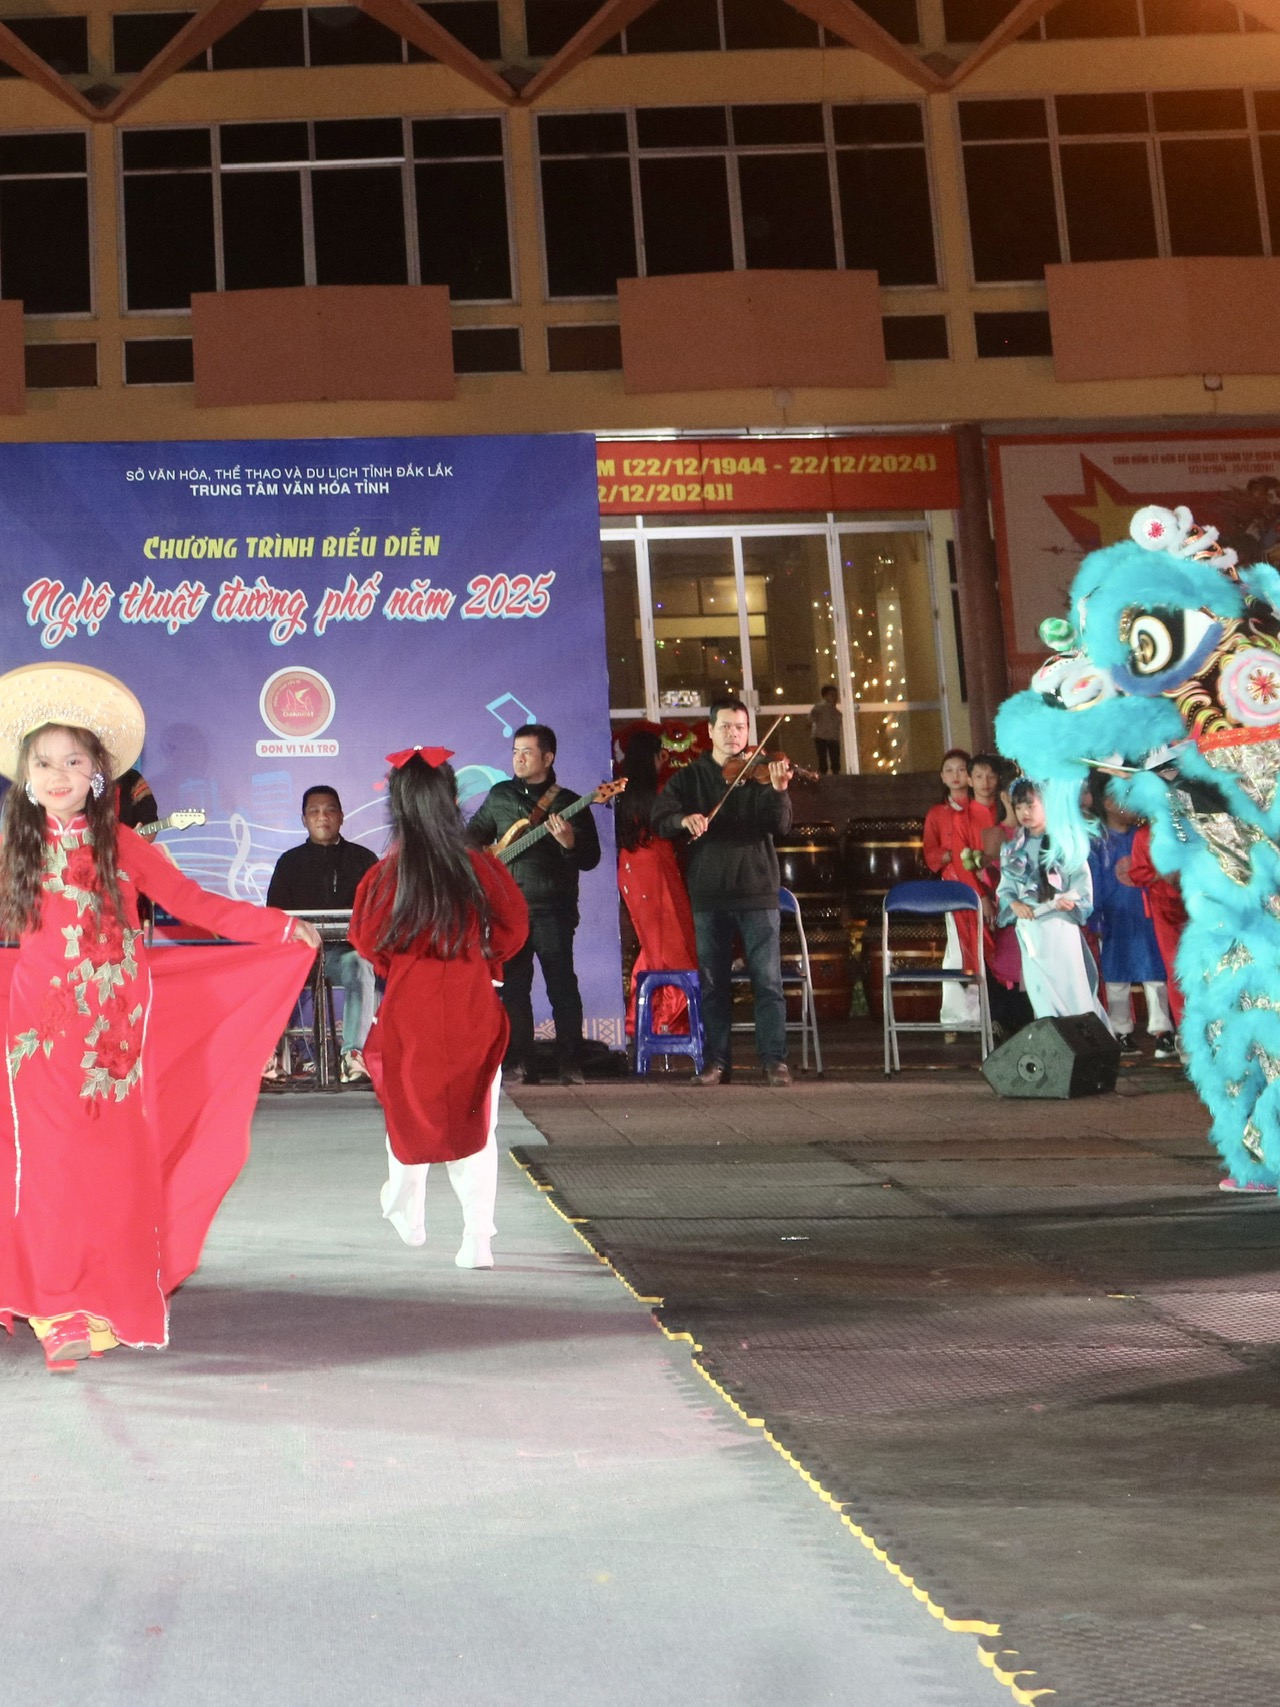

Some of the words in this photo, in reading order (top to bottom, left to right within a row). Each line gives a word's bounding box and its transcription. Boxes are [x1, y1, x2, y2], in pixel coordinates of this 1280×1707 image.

[126, 467, 144, 481] SỞ
[148, 468, 175, 480] VĂN
[179, 468, 211, 481] HÓA,
[214, 465, 241, 480] THỂ
[245, 468, 282, 480] THAO
[284, 466, 302, 479] VÀ
[306, 468, 325, 479] DU
[328, 467, 358, 480] LỊCH
[362, 464, 393, 478] TỈNH
[396, 463, 424, 477] ĐẮK
[427, 463, 454, 477] LẮK
[623, 457, 767, 476] (22/12/1944
[789, 454, 937, 474] 22/12/2024)
[190, 484, 242, 496] TRUNG
[246, 481, 278, 495] TÂM
[283, 480, 314, 495] VĂN
[318, 480, 351, 495] HÓA
[354, 479, 390, 494] TỈNH
[143, 536, 237, 559] CHƯƠNG
[246, 533, 315, 558] TRÌNH
[322, 527, 377, 557] BIỂU
[384, 527, 441, 556] DIỄN
[23, 577, 115, 649] Nghệ
[120, 575, 211, 635] thuật
[211, 575, 308, 646] đường
[313, 571, 383, 637] phố
[382, 579, 457, 622] năm
[460, 570, 556, 620] 2025
